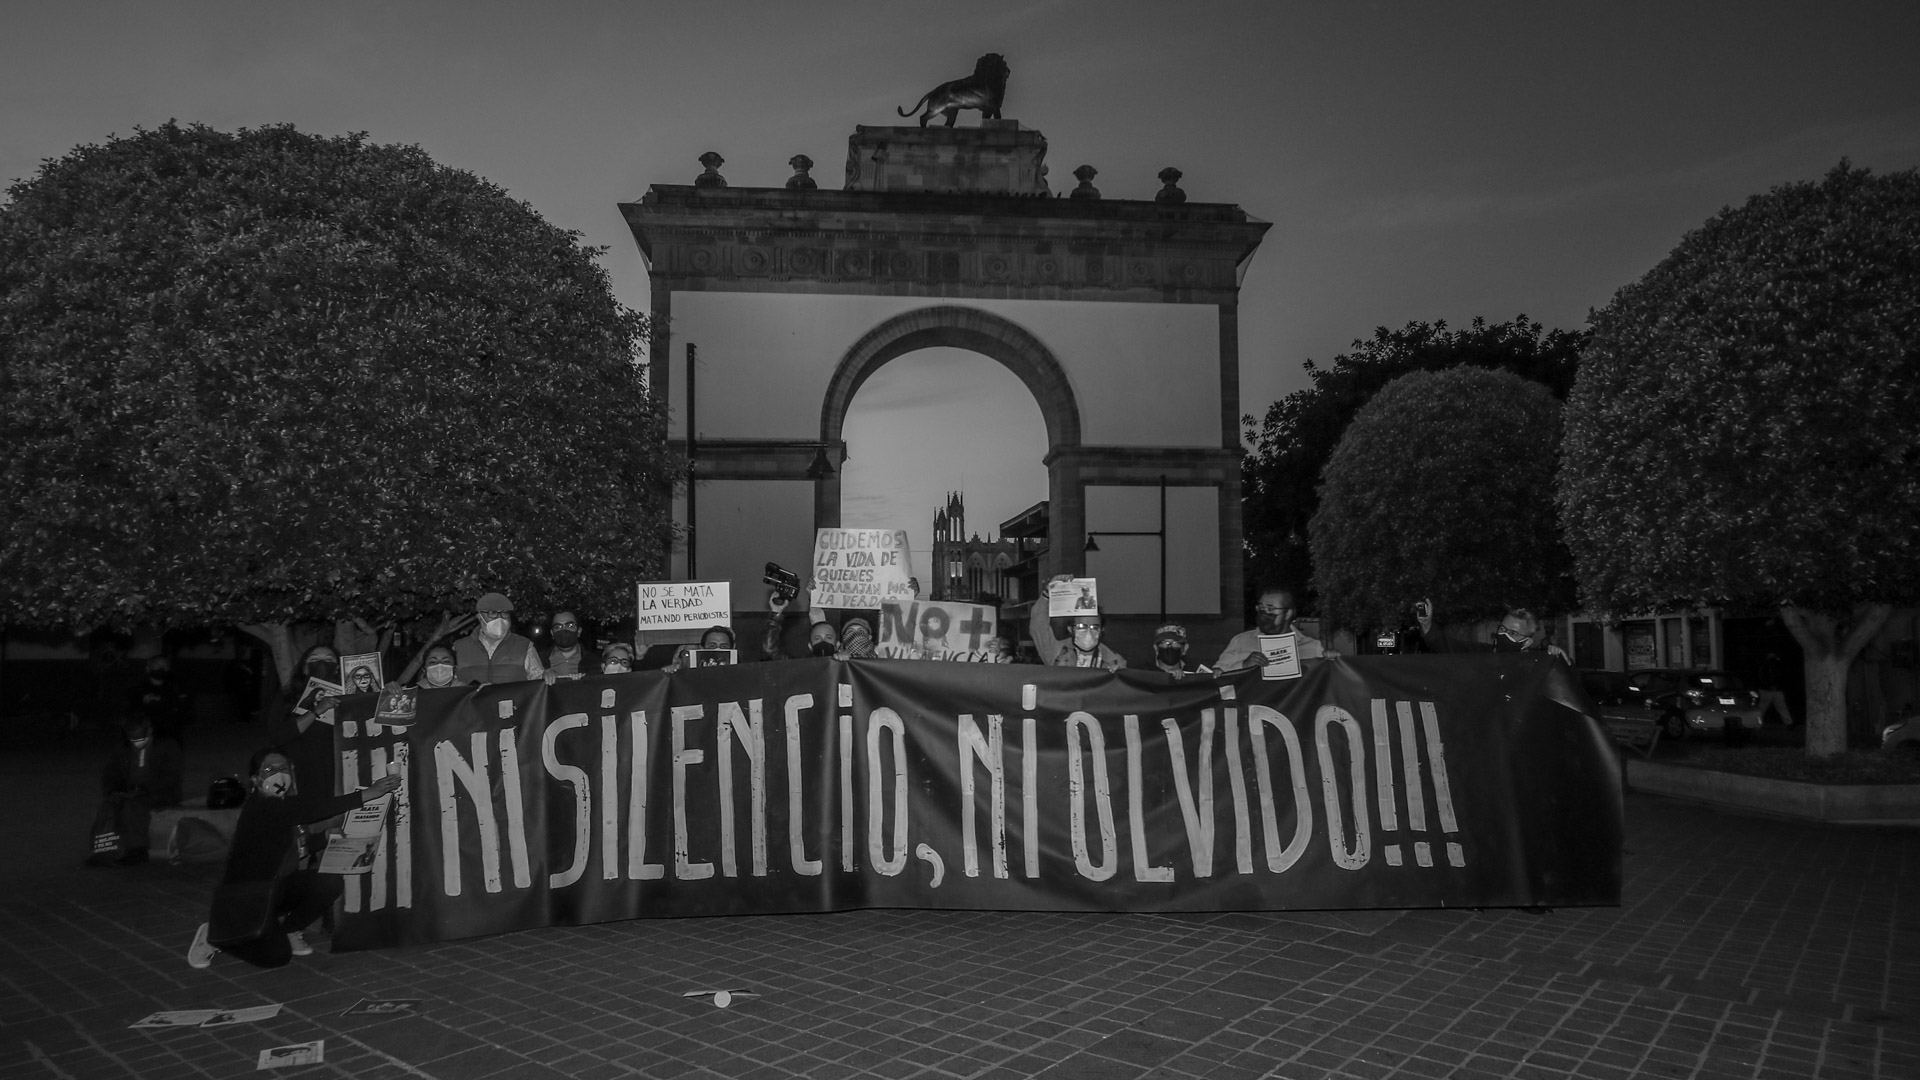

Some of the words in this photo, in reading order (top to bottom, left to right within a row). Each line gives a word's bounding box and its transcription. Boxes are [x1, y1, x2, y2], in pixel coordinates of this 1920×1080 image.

[818, 530, 904, 550] CUIDEMOS
[817, 551, 838, 567] LA
[846, 551, 875, 567] VIDA
[881, 551, 899, 566] DE
[817, 568, 874, 582] QUIENES
[642, 586, 657, 598] NO
[661, 586, 675, 597] SE
[683, 585, 714, 598] MATA
[819, 581, 881, 595] TRABAJAN
[887, 581, 908, 595] POR
[642, 599, 657, 610] LA
[661, 598, 703, 609] VERDAD
[816, 593, 834, 605] LA
[842, 595, 897, 607] VERDA
[640, 613, 681, 624] MATANDO
[683, 611, 729, 621] PERIODISTAS
[881, 602, 950, 643] NO
